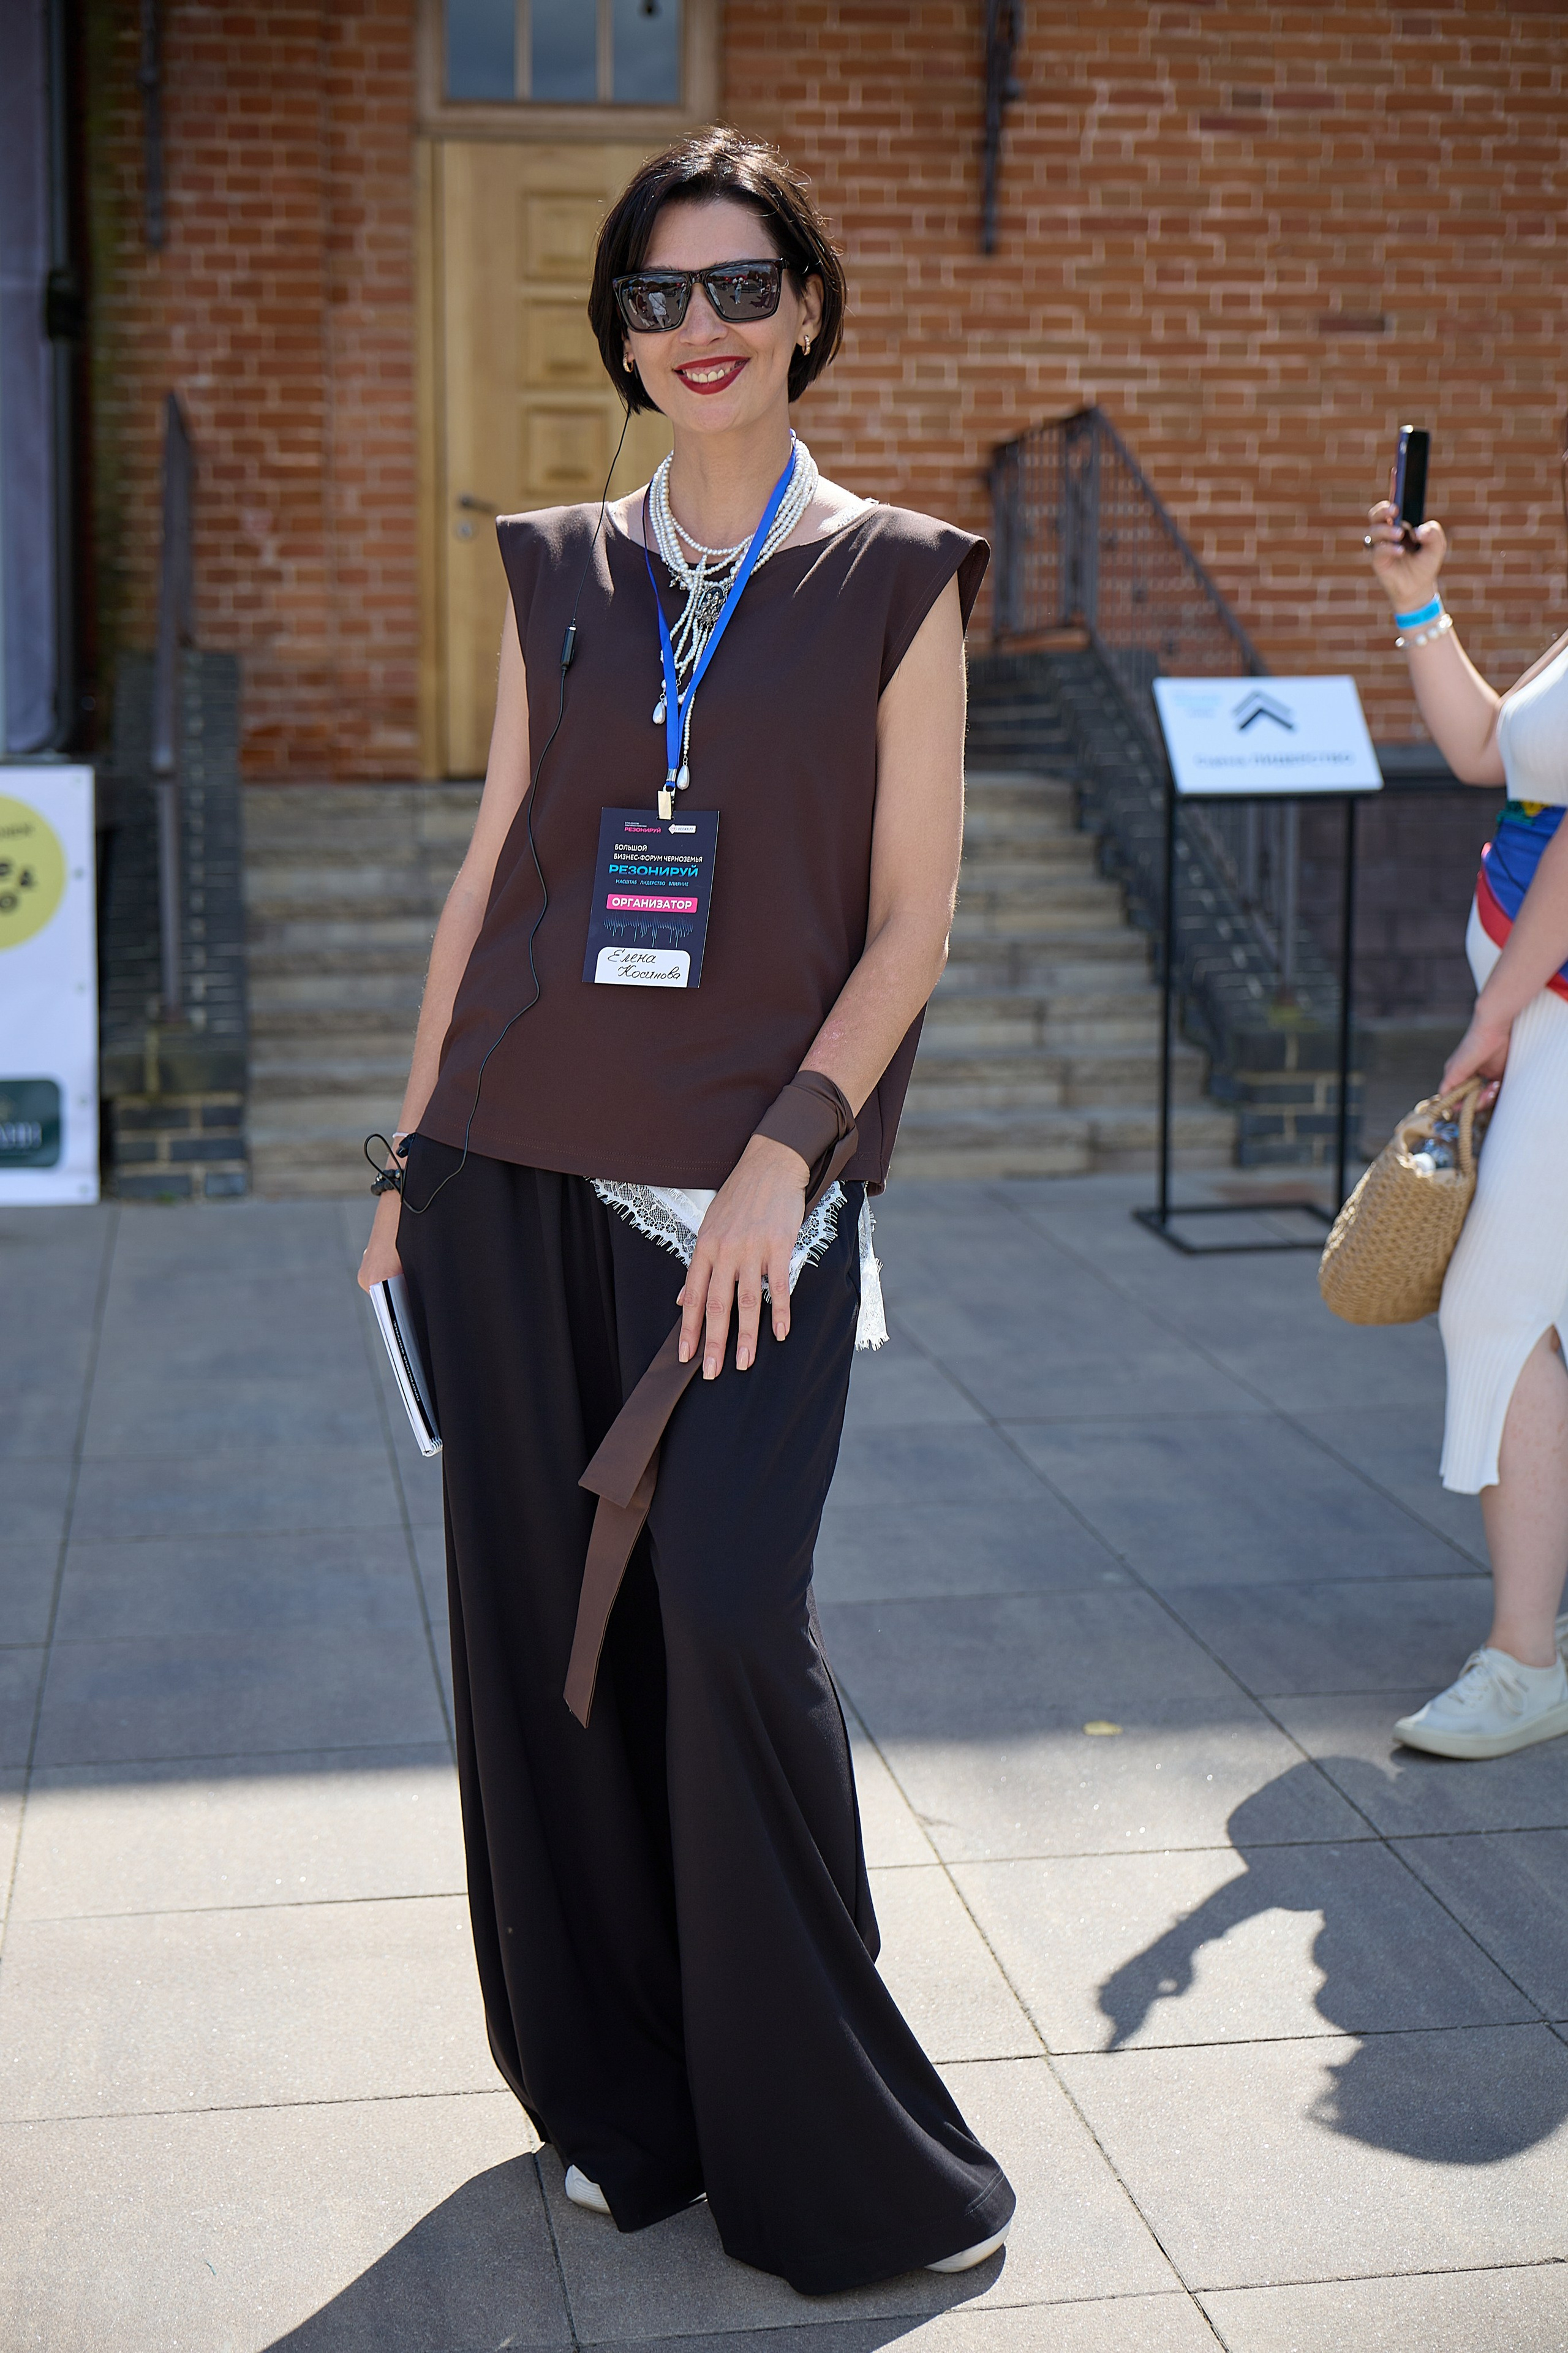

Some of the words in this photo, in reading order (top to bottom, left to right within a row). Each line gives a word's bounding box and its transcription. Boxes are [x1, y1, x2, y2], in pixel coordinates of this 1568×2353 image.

[614, 853, 663, 862] БИЗНЕС-ФОРУМ
[609, 864, 698, 877] РЕЗОНИРУЙ
[612, 897, 692, 909] ОРГАНИЗАТОР
[607, 948, 657, 964] Елена
[617, 964, 681, 980] Косинова
[403, 1356, 420, 1402] ПРОГРАММА
